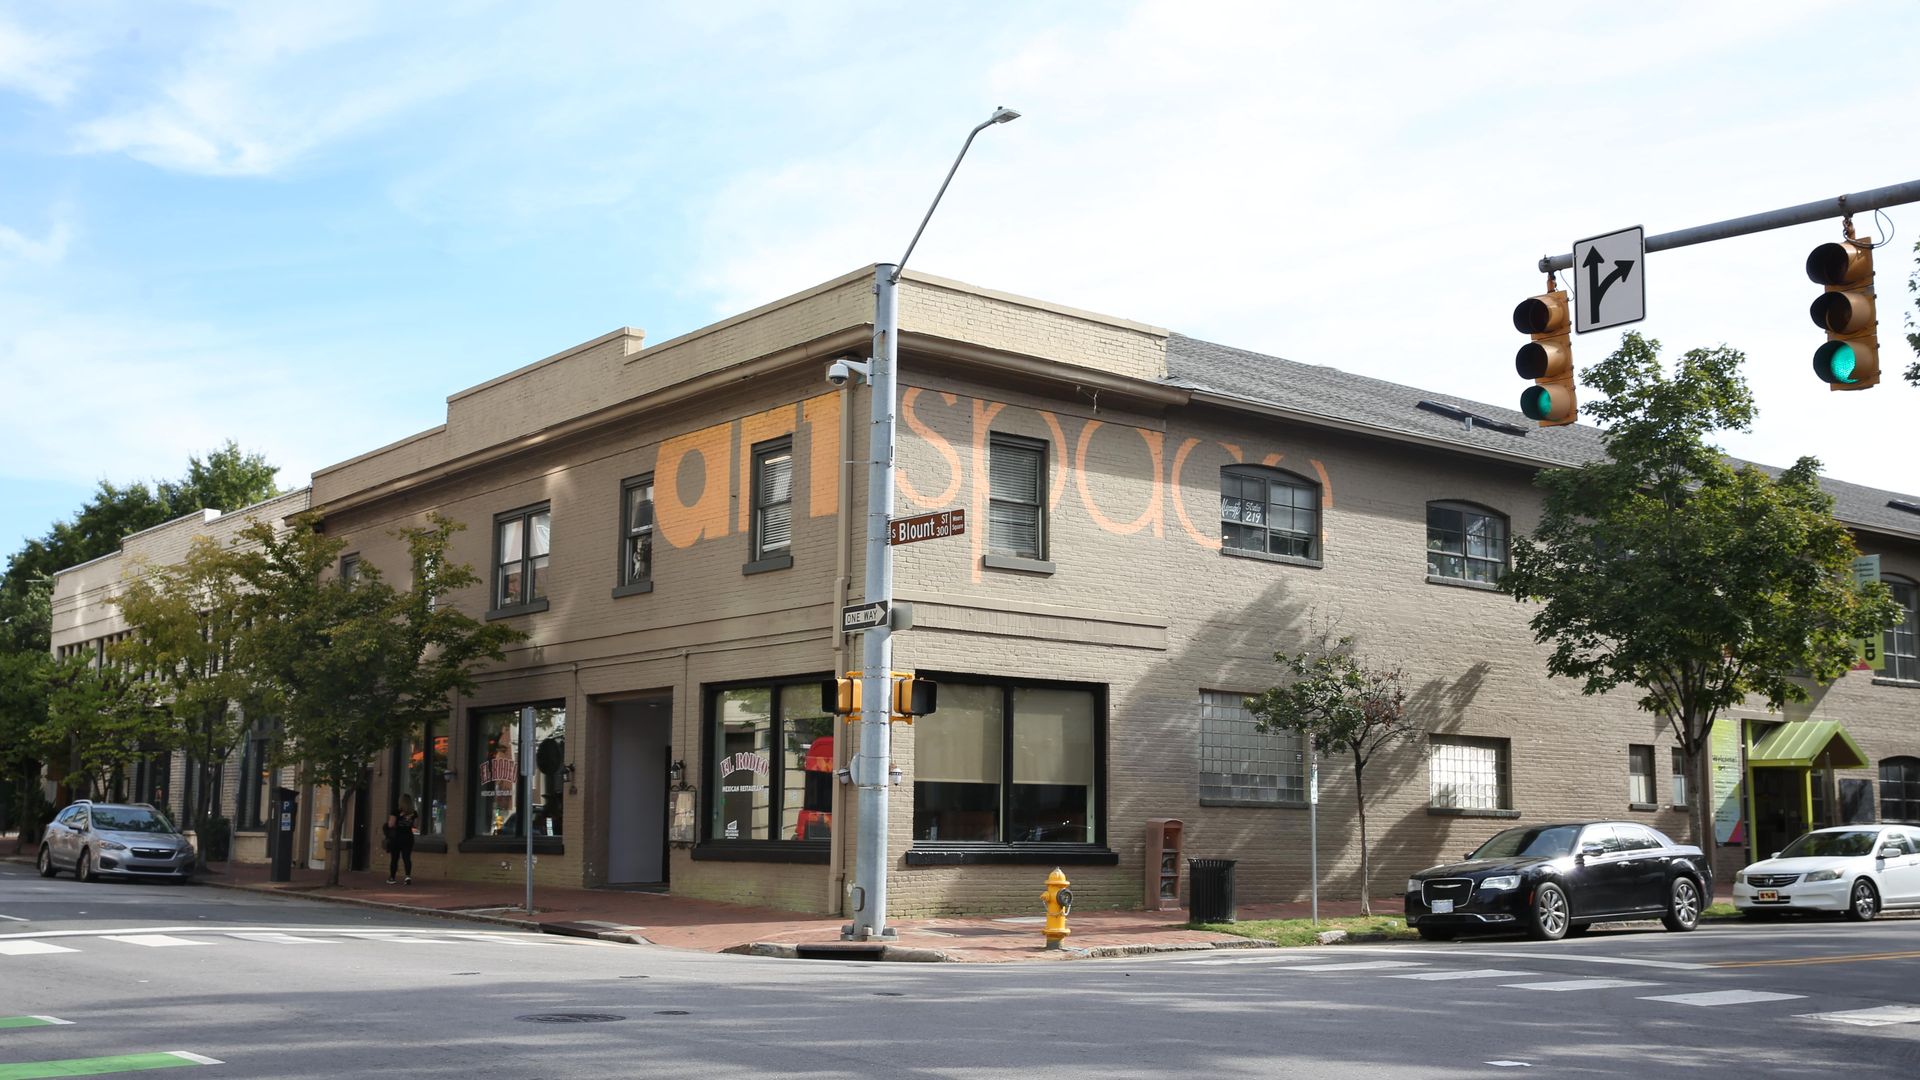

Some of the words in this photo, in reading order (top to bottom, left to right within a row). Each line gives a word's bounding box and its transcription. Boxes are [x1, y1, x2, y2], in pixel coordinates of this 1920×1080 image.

[1246, 511, 1261, 524] 219
[892, 528, 897, 538] S
[899, 517, 935, 542] Blount
[941, 513, 949, 525] ST
[936, 525, 949, 537] 300
[952, 523, 964, 531] Square
[846, 612, 861, 624] ONE
[864, 609, 878, 621] WAY
[480, 760, 491, 785] EL
[491, 757, 518, 783] RODEO
[720, 756, 735, 778] EL
[735, 752, 769, 777] RODEO
[283, 801, 290, 811] P
